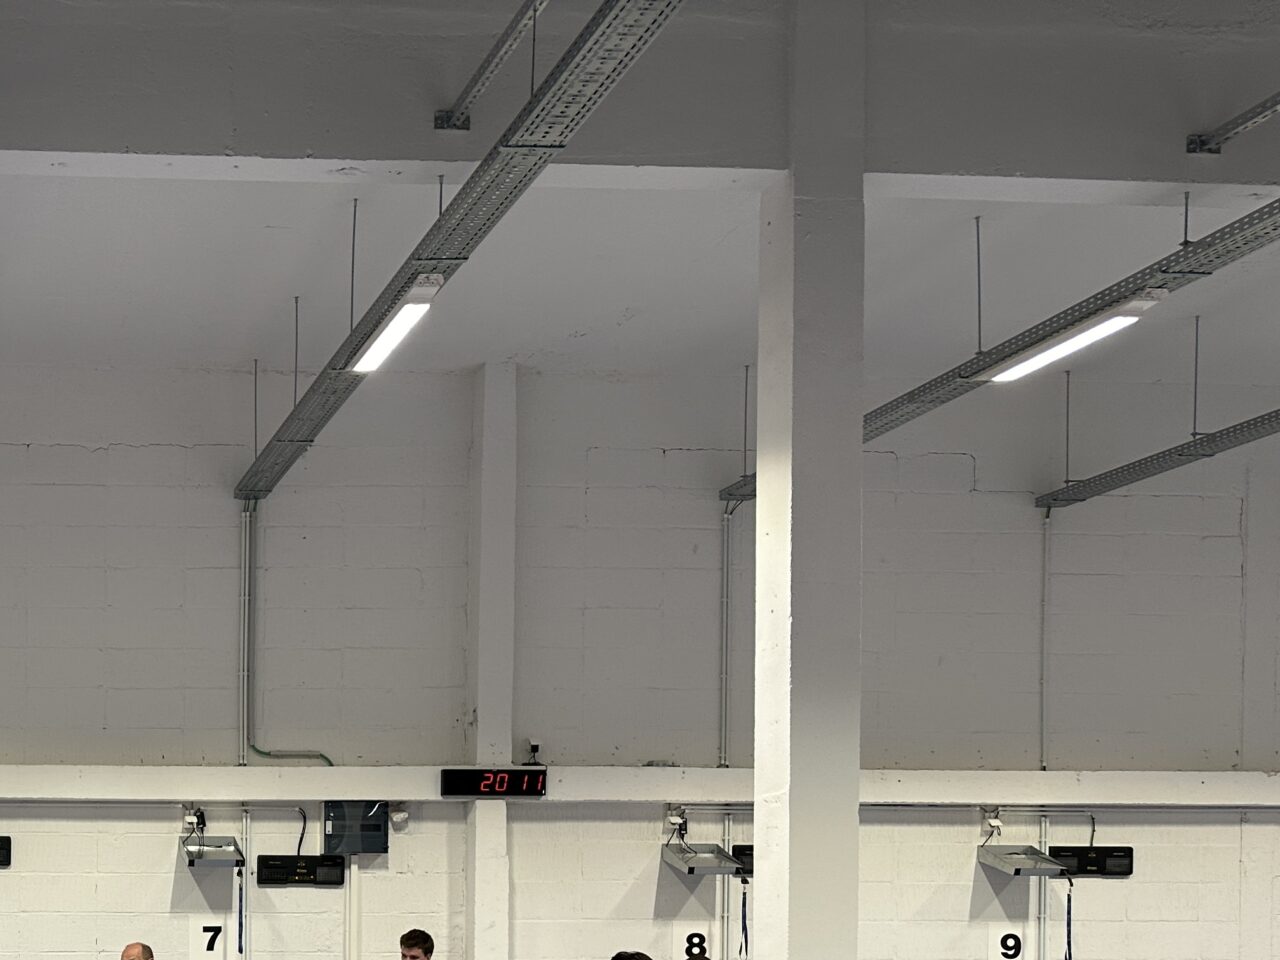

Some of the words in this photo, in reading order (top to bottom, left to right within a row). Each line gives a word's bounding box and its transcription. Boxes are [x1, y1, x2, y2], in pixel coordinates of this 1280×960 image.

[202, 926, 222, 951] 7
[685, 932, 707, 957] 8
[1000, 933, 1021, 959] 9
